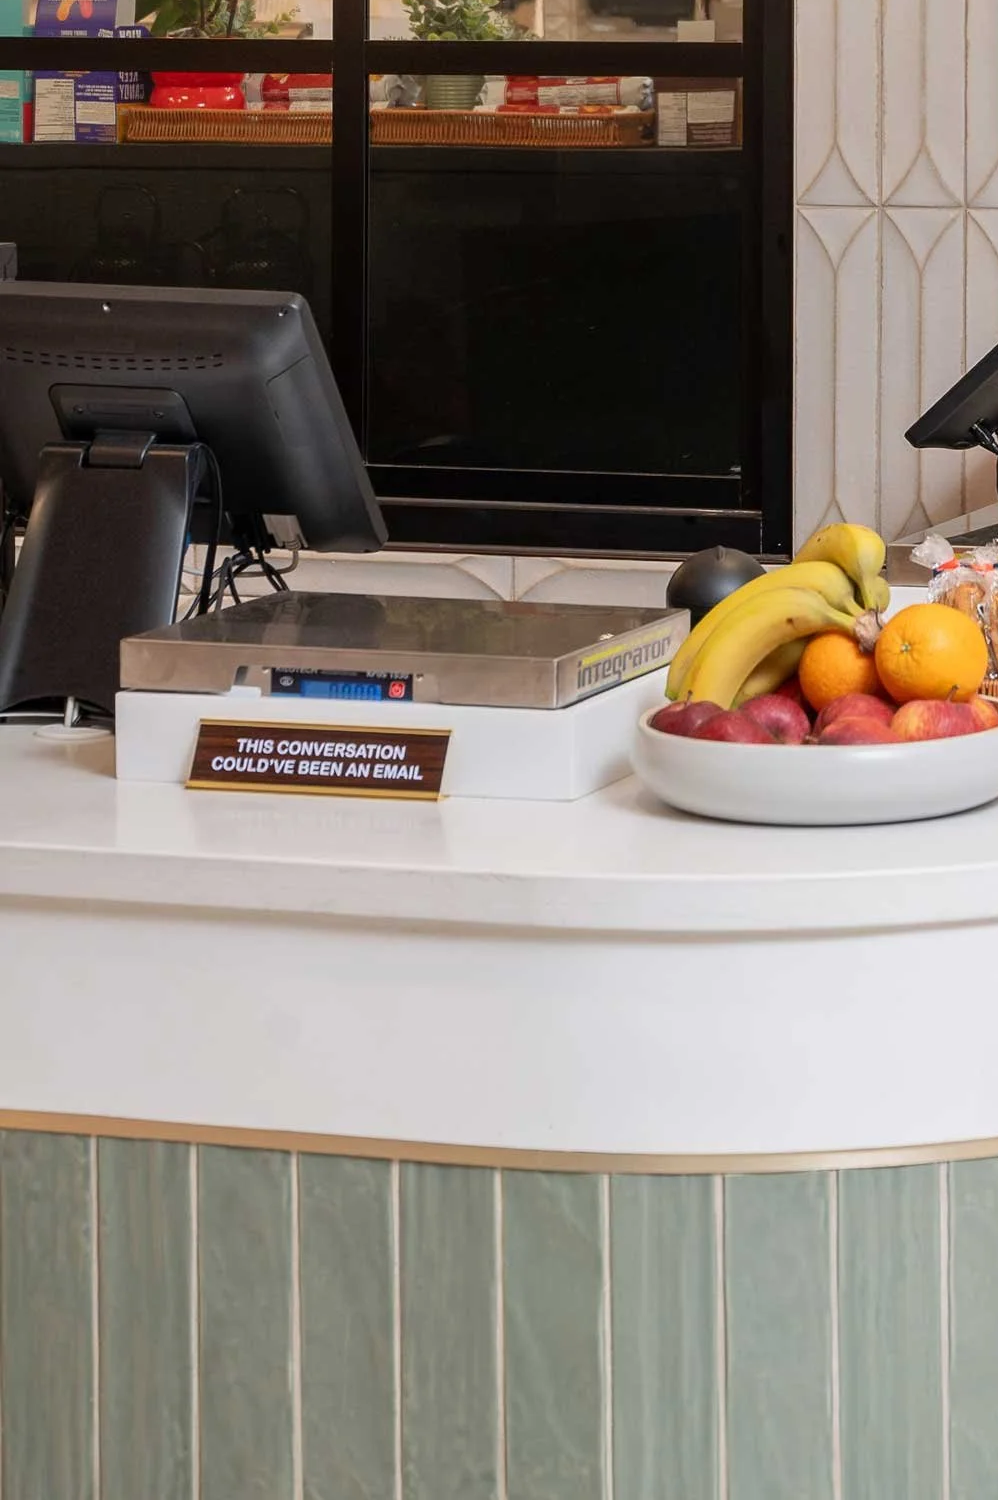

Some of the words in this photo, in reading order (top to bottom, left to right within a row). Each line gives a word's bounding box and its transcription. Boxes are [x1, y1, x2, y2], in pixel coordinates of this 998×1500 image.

[577, 636, 671, 690] integrator
[237, 738, 274, 755] THIS
[277, 740, 407, 760] CONVERSATION
[211, 756, 295, 775] COULD'VE
[298, 760, 344, 777] BEEN
[345, 762, 370, 778] AN
[373, 764, 424, 781] EMAIL
